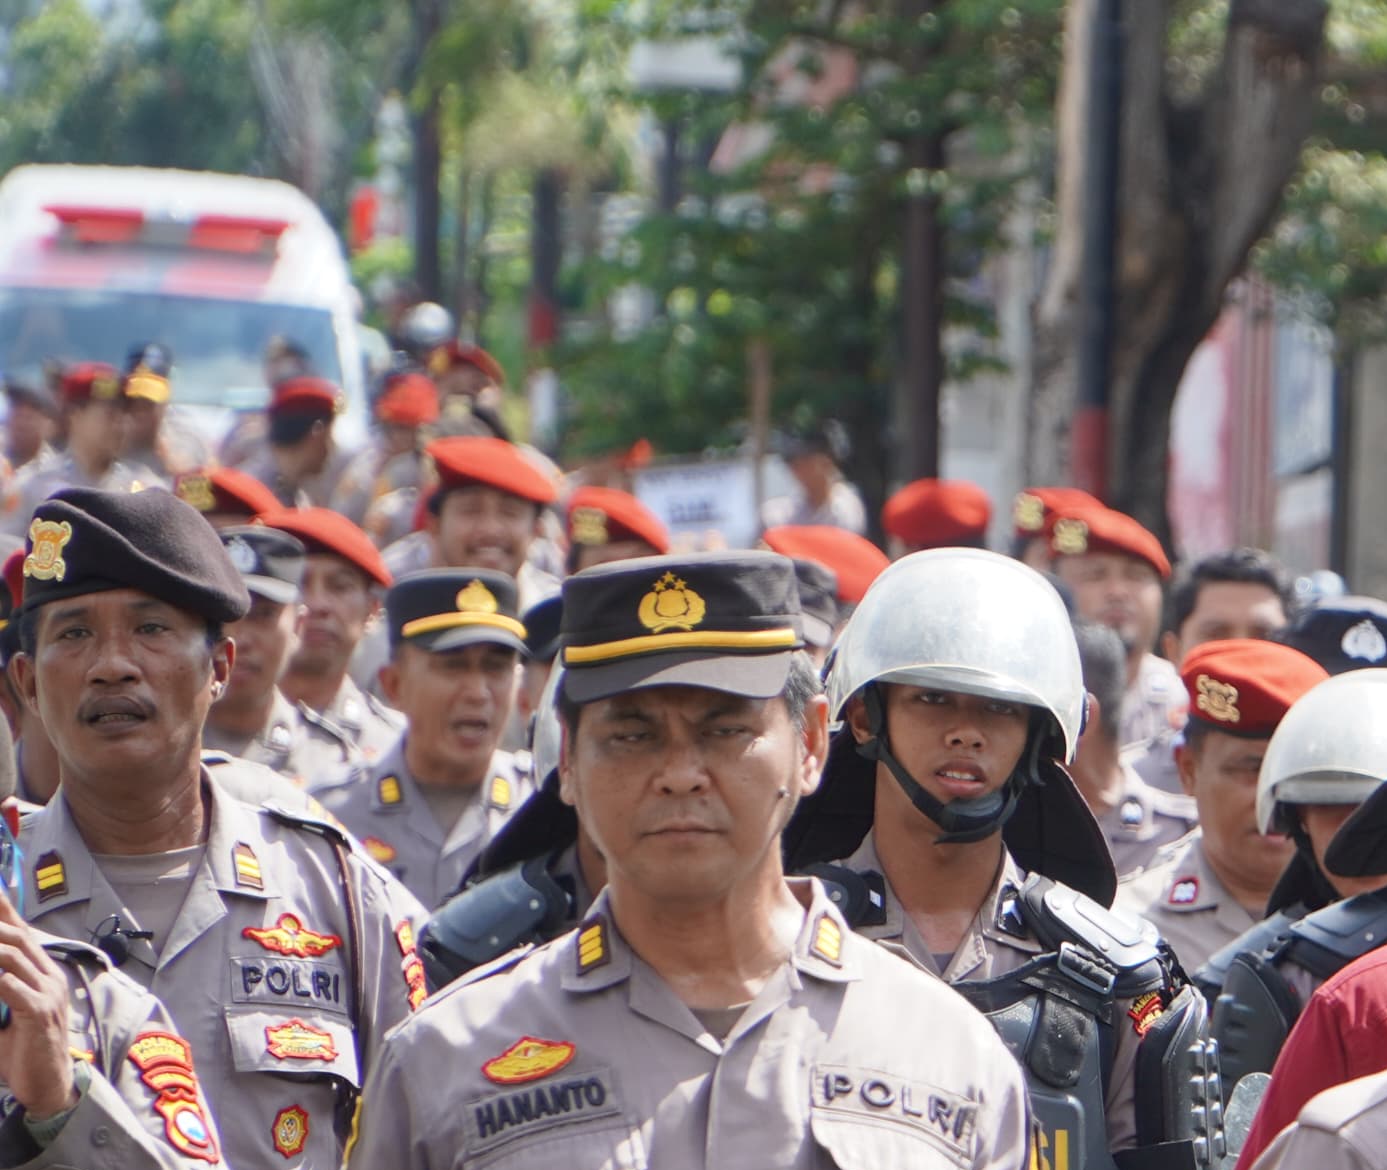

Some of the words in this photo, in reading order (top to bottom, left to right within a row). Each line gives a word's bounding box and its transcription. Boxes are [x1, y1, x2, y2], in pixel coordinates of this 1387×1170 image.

[241, 965, 340, 1004] POLRI
[475, 1076, 606, 1138] HANANTO
[823, 1072, 971, 1139] POLRI
